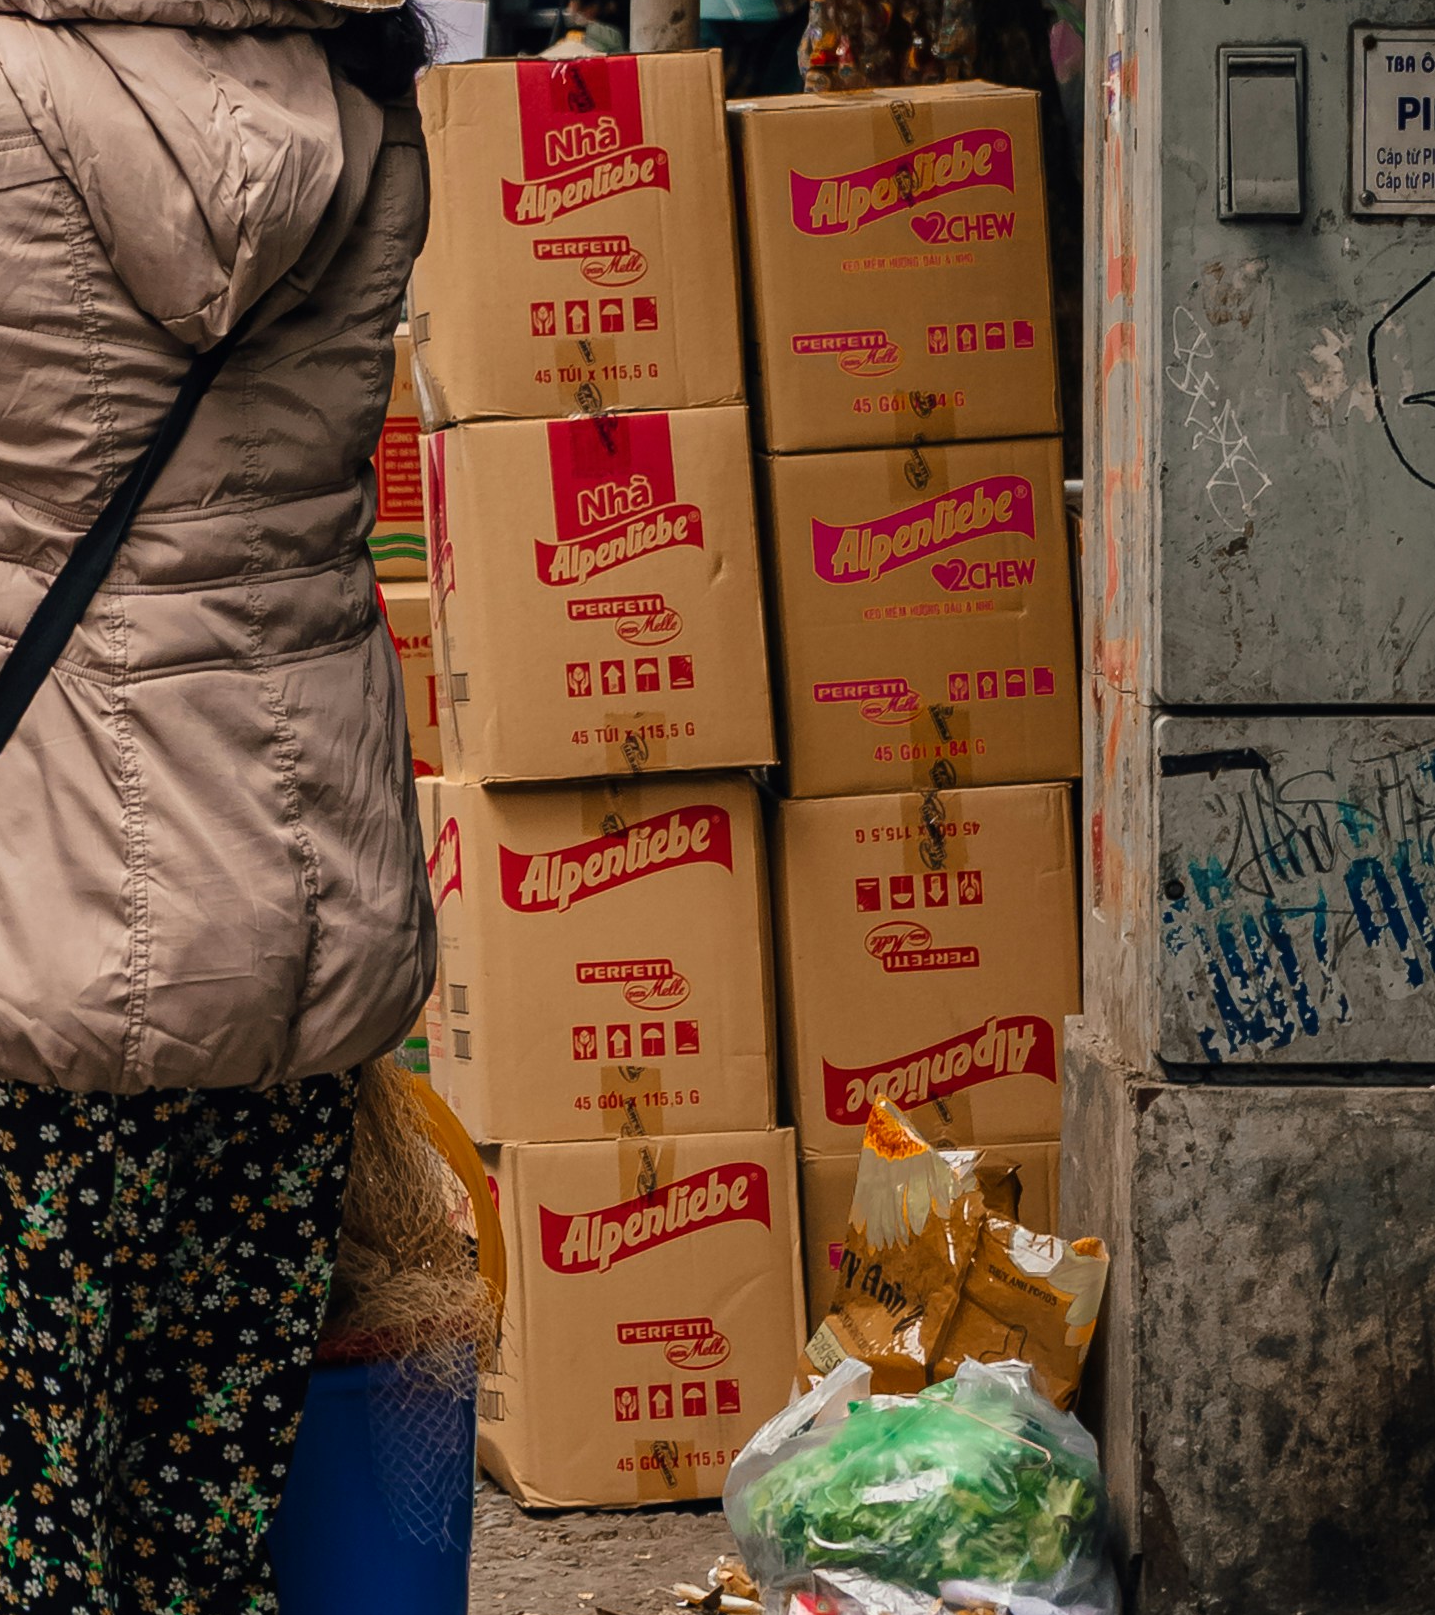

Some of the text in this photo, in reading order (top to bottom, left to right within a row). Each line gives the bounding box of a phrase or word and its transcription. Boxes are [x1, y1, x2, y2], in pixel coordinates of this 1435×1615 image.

[1385, 55, 1416, 73] TBA
[544, 122, 621, 166] Nhà
[1376, 147, 1403, 170] Cáp
[516, 152, 659, 223] Alpenliebe
[1376, 171, 1402, 193] Cáp
[929, 211, 1017, 245] 2CHEW
[535, 239, 628, 259] PERFETTI
[604, 249, 644, 278] Melle
[795, 335, 884, 352] PERFETTI
[534, 367, 552, 384] 45
[556, 363, 584, 383] TÚI
[600, 363, 641, 383] 115,5
[647, 362, 658, 379] G
[853, 398, 871, 414] 45
[955, 392, 965, 407] G
[577, 476, 653, 525] Nhà
[831, 486, 1012, 584] Alpenliebe
[548, 510, 691, 585] Alpenliebe
[950, 558, 1037, 591] 2CHEW
[570, 598, 663, 618] PERFETTI
[637, 611, 678, 638] Melle
[818, 682, 905, 700] PERFETTI
[571, 728, 589, 746] 45
[592, 723, 620, 744] TÚI
[637, 722, 679, 742] 115,5
[684, 721, 696, 739] G
[874, 746, 892, 762] 45
[950, 740, 968, 757] 84
[975, 739, 986, 755] G
[855, 829, 866, 844] G
[871, 824, 912, 843] 115,5
[963, 821, 980, 836] 45
[518, 813, 711, 913] Alpenliebe
[887, 951, 976, 969] PERFETTI
[580, 963, 670, 981] PERFETTI
[646, 977, 686, 998] Melle
[846, 1016, 1038, 1113] Alpenliebe
[574, 1095, 591, 1111] 45
[643, 1090, 684, 1108] 115,5
[689, 1089, 700, 1105] G
[559, 1171, 749, 1273] Alpenliebe
[622, 1323, 711, 1341] PERFETTI
[687, 1336, 727, 1358] Melle
[617, 1457, 634, 1472] 45
[685, 1451, 726, 1469] 115,5
